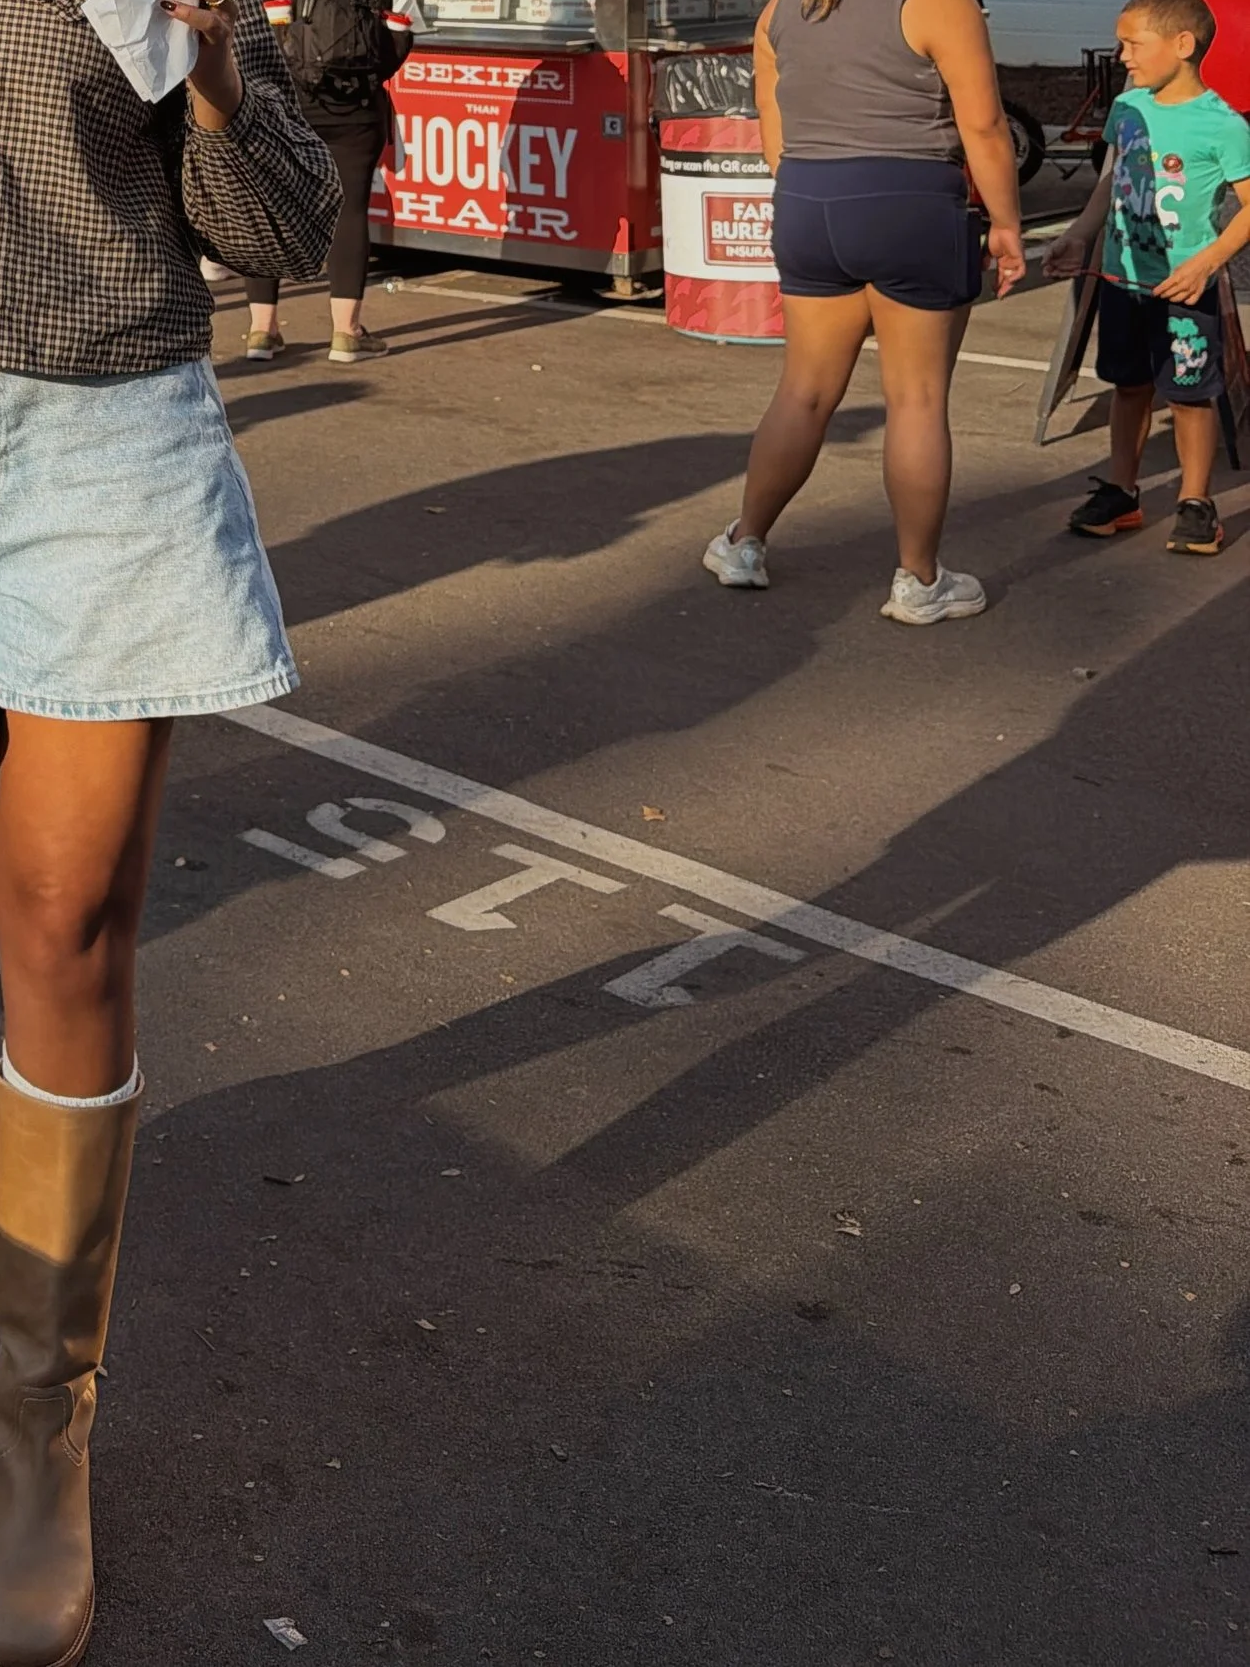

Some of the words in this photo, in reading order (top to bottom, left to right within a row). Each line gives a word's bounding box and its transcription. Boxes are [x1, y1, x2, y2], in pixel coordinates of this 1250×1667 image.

[403, 62, 566, 91] SEXIER
[466, 103, 500, 116] THAN
[395, 113, 578, 200] HOCKEY
[682, 161, 703, 172] scan
[703, 158, 720, 173] the
[720, 159, 741, 173] QR
[741, 158, 771, 173] code
[394, 190, 579, 242] HAIR
